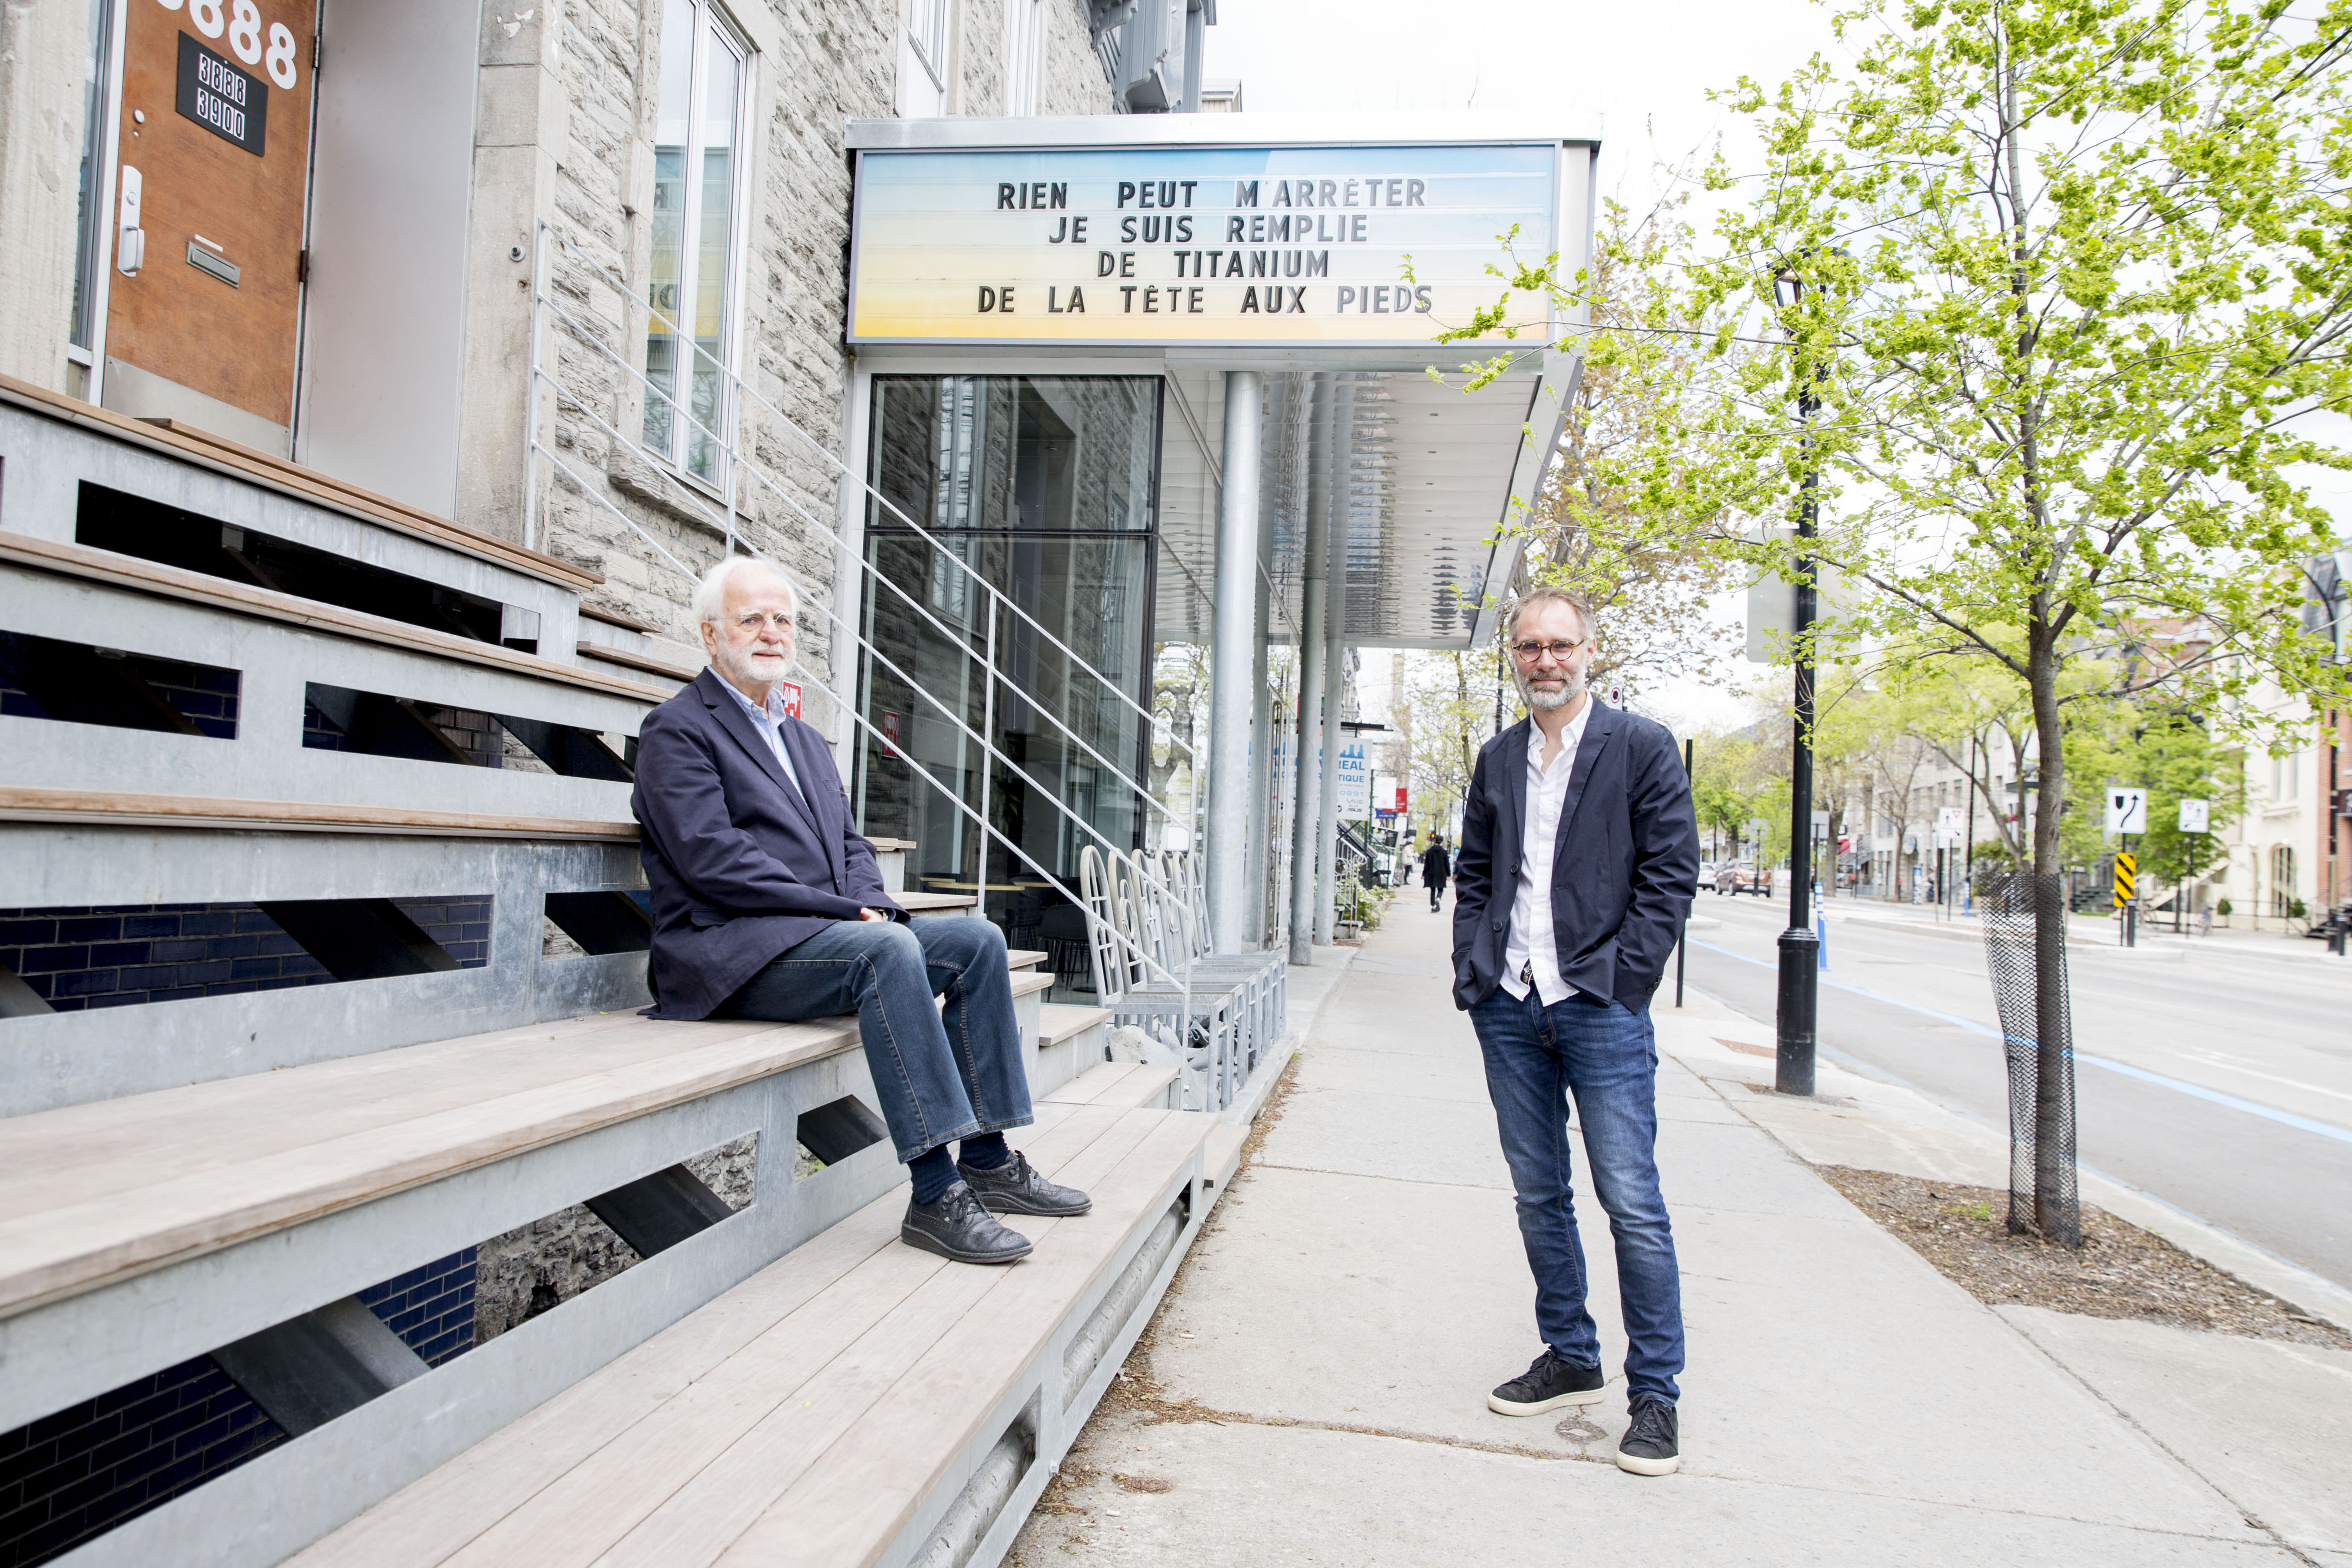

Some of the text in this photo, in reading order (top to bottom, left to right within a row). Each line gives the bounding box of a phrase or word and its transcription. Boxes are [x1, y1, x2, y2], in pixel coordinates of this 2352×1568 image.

[157, 0, 297, 89] 888
[201, 56, 244, 104] 3888
[199, 90, 243, 138] 3900
[997, 182, 1067, 209] RIEN
[1118, 181, 1198, 209] PEUT
[1049, 215, 1367, 243] JE SUIS REMPLIE
[1097, 250, 1328, 277] DE TITANIUM
[978, 285, 1432, 313] DE LA TÊTE AUX PIEDS
